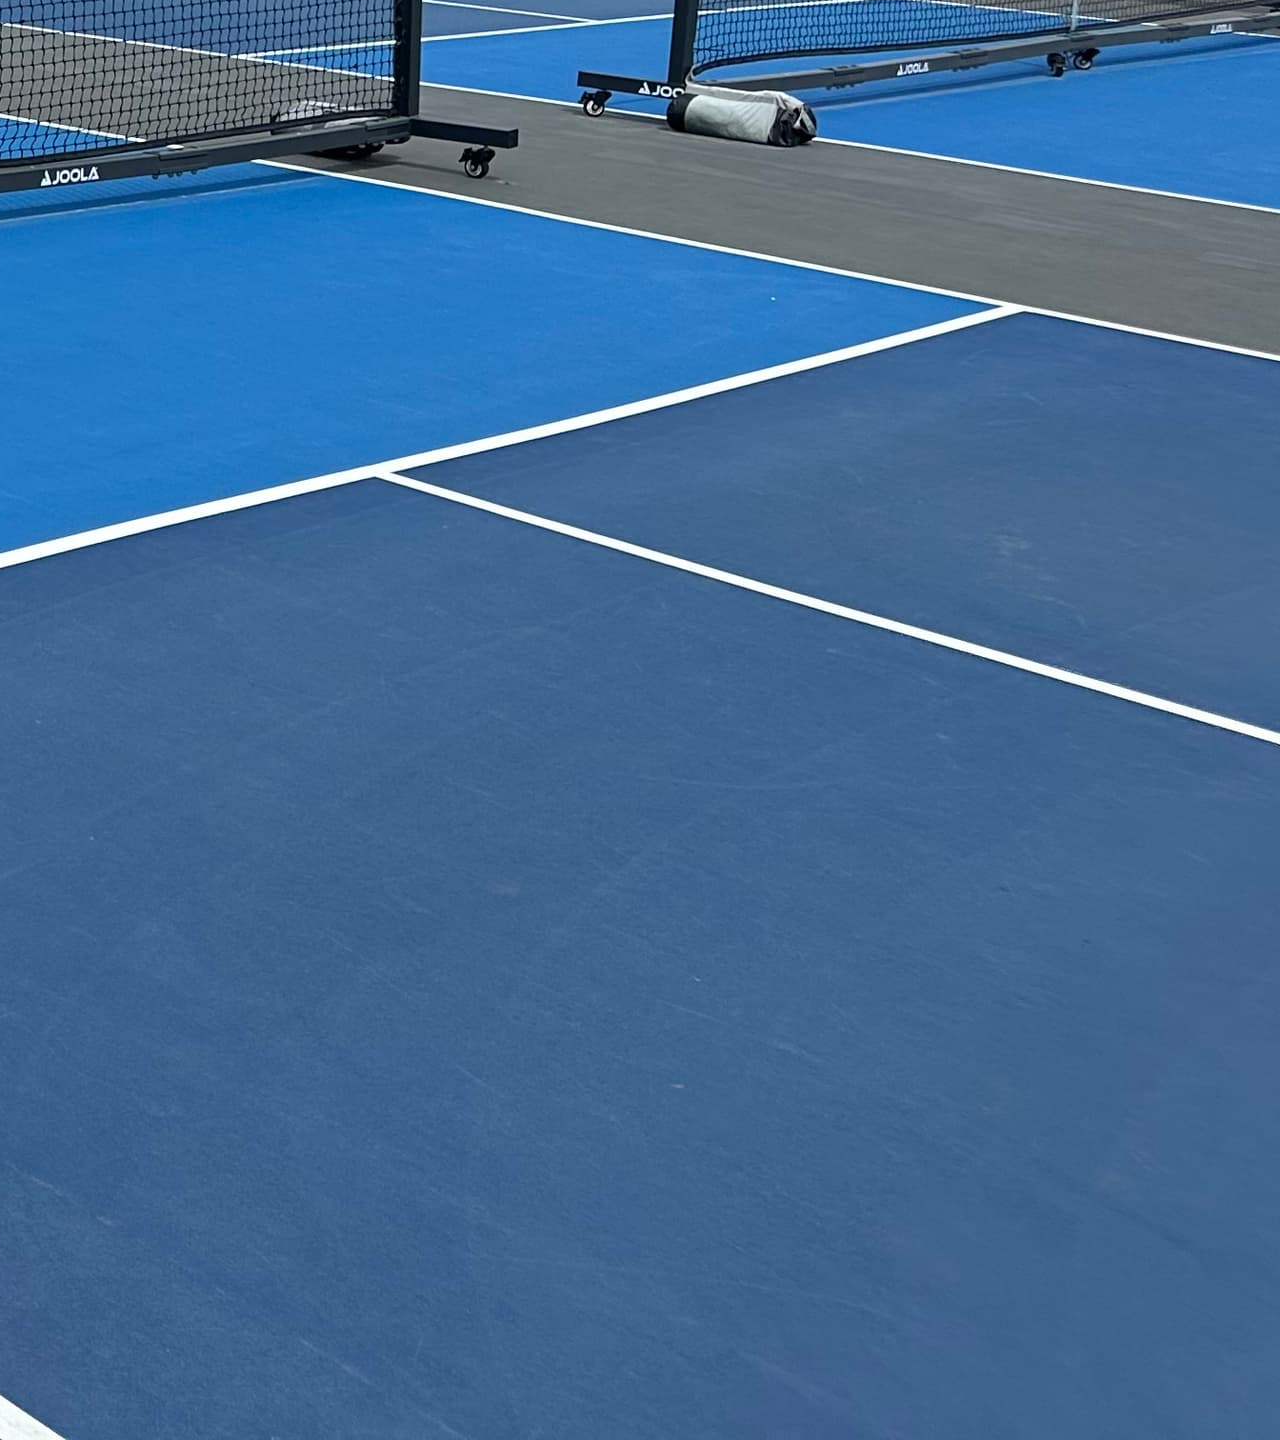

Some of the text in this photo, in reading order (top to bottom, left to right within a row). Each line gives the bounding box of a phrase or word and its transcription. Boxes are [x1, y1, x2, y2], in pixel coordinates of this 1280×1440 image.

[901, 62, 929, 76] JOOLA
[651, 85, 685, 98] JOO
[52, 166, 99, 184] JOOLA
